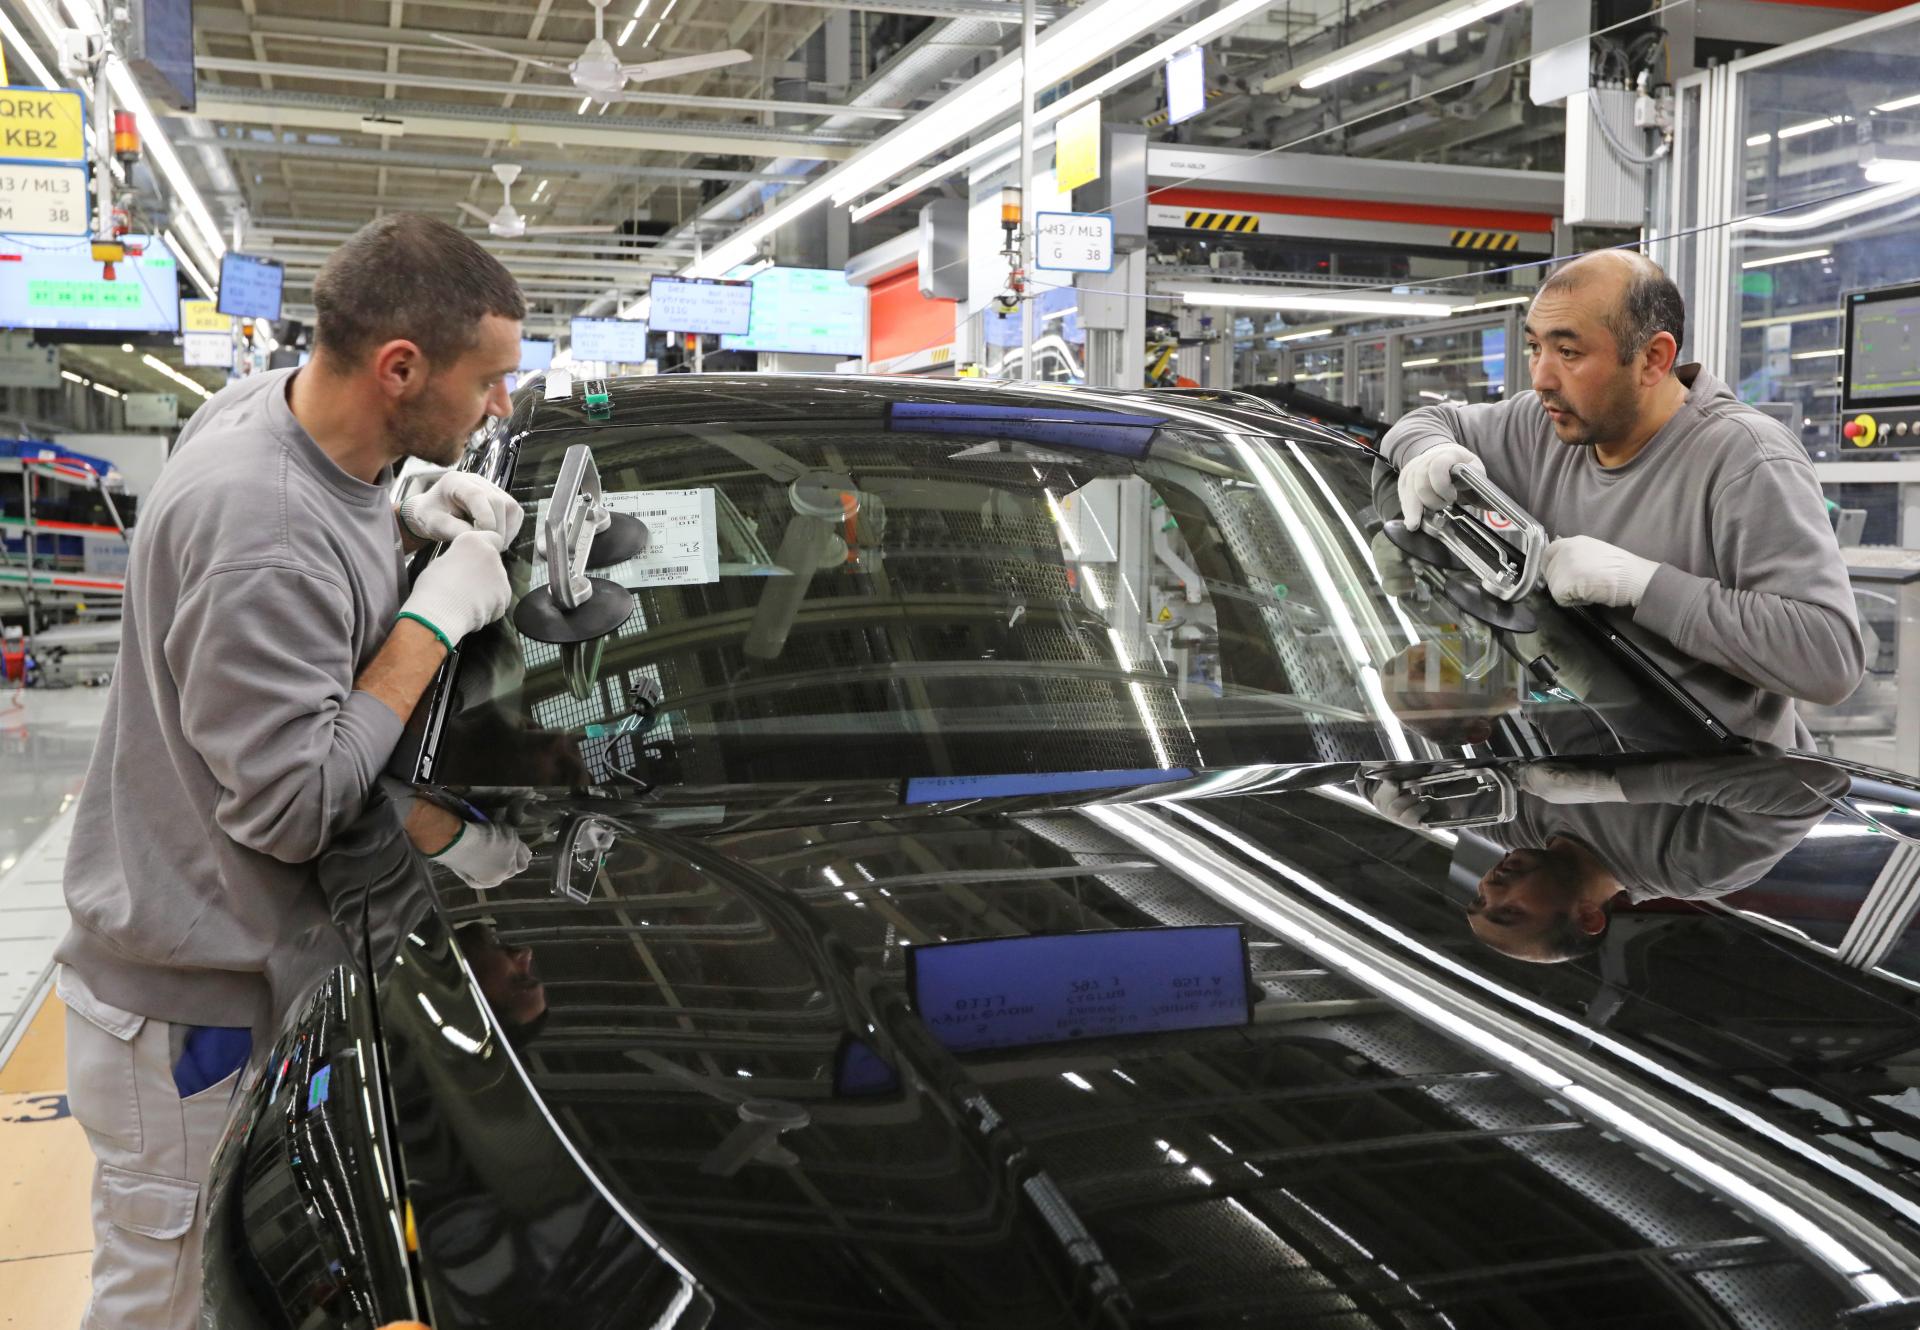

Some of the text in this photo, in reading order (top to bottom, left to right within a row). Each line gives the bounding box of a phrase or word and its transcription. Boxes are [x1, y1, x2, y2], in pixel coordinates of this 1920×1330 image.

[6, 128, 58, 148] KB2
[0, 176, 15, 192] 3
[34, 178, 70, 194] ML3
[48, 208, 70, 222] 38
[1078, 226, 1102, 237] ML3
[1054, 248, 1101, 260] G 38
